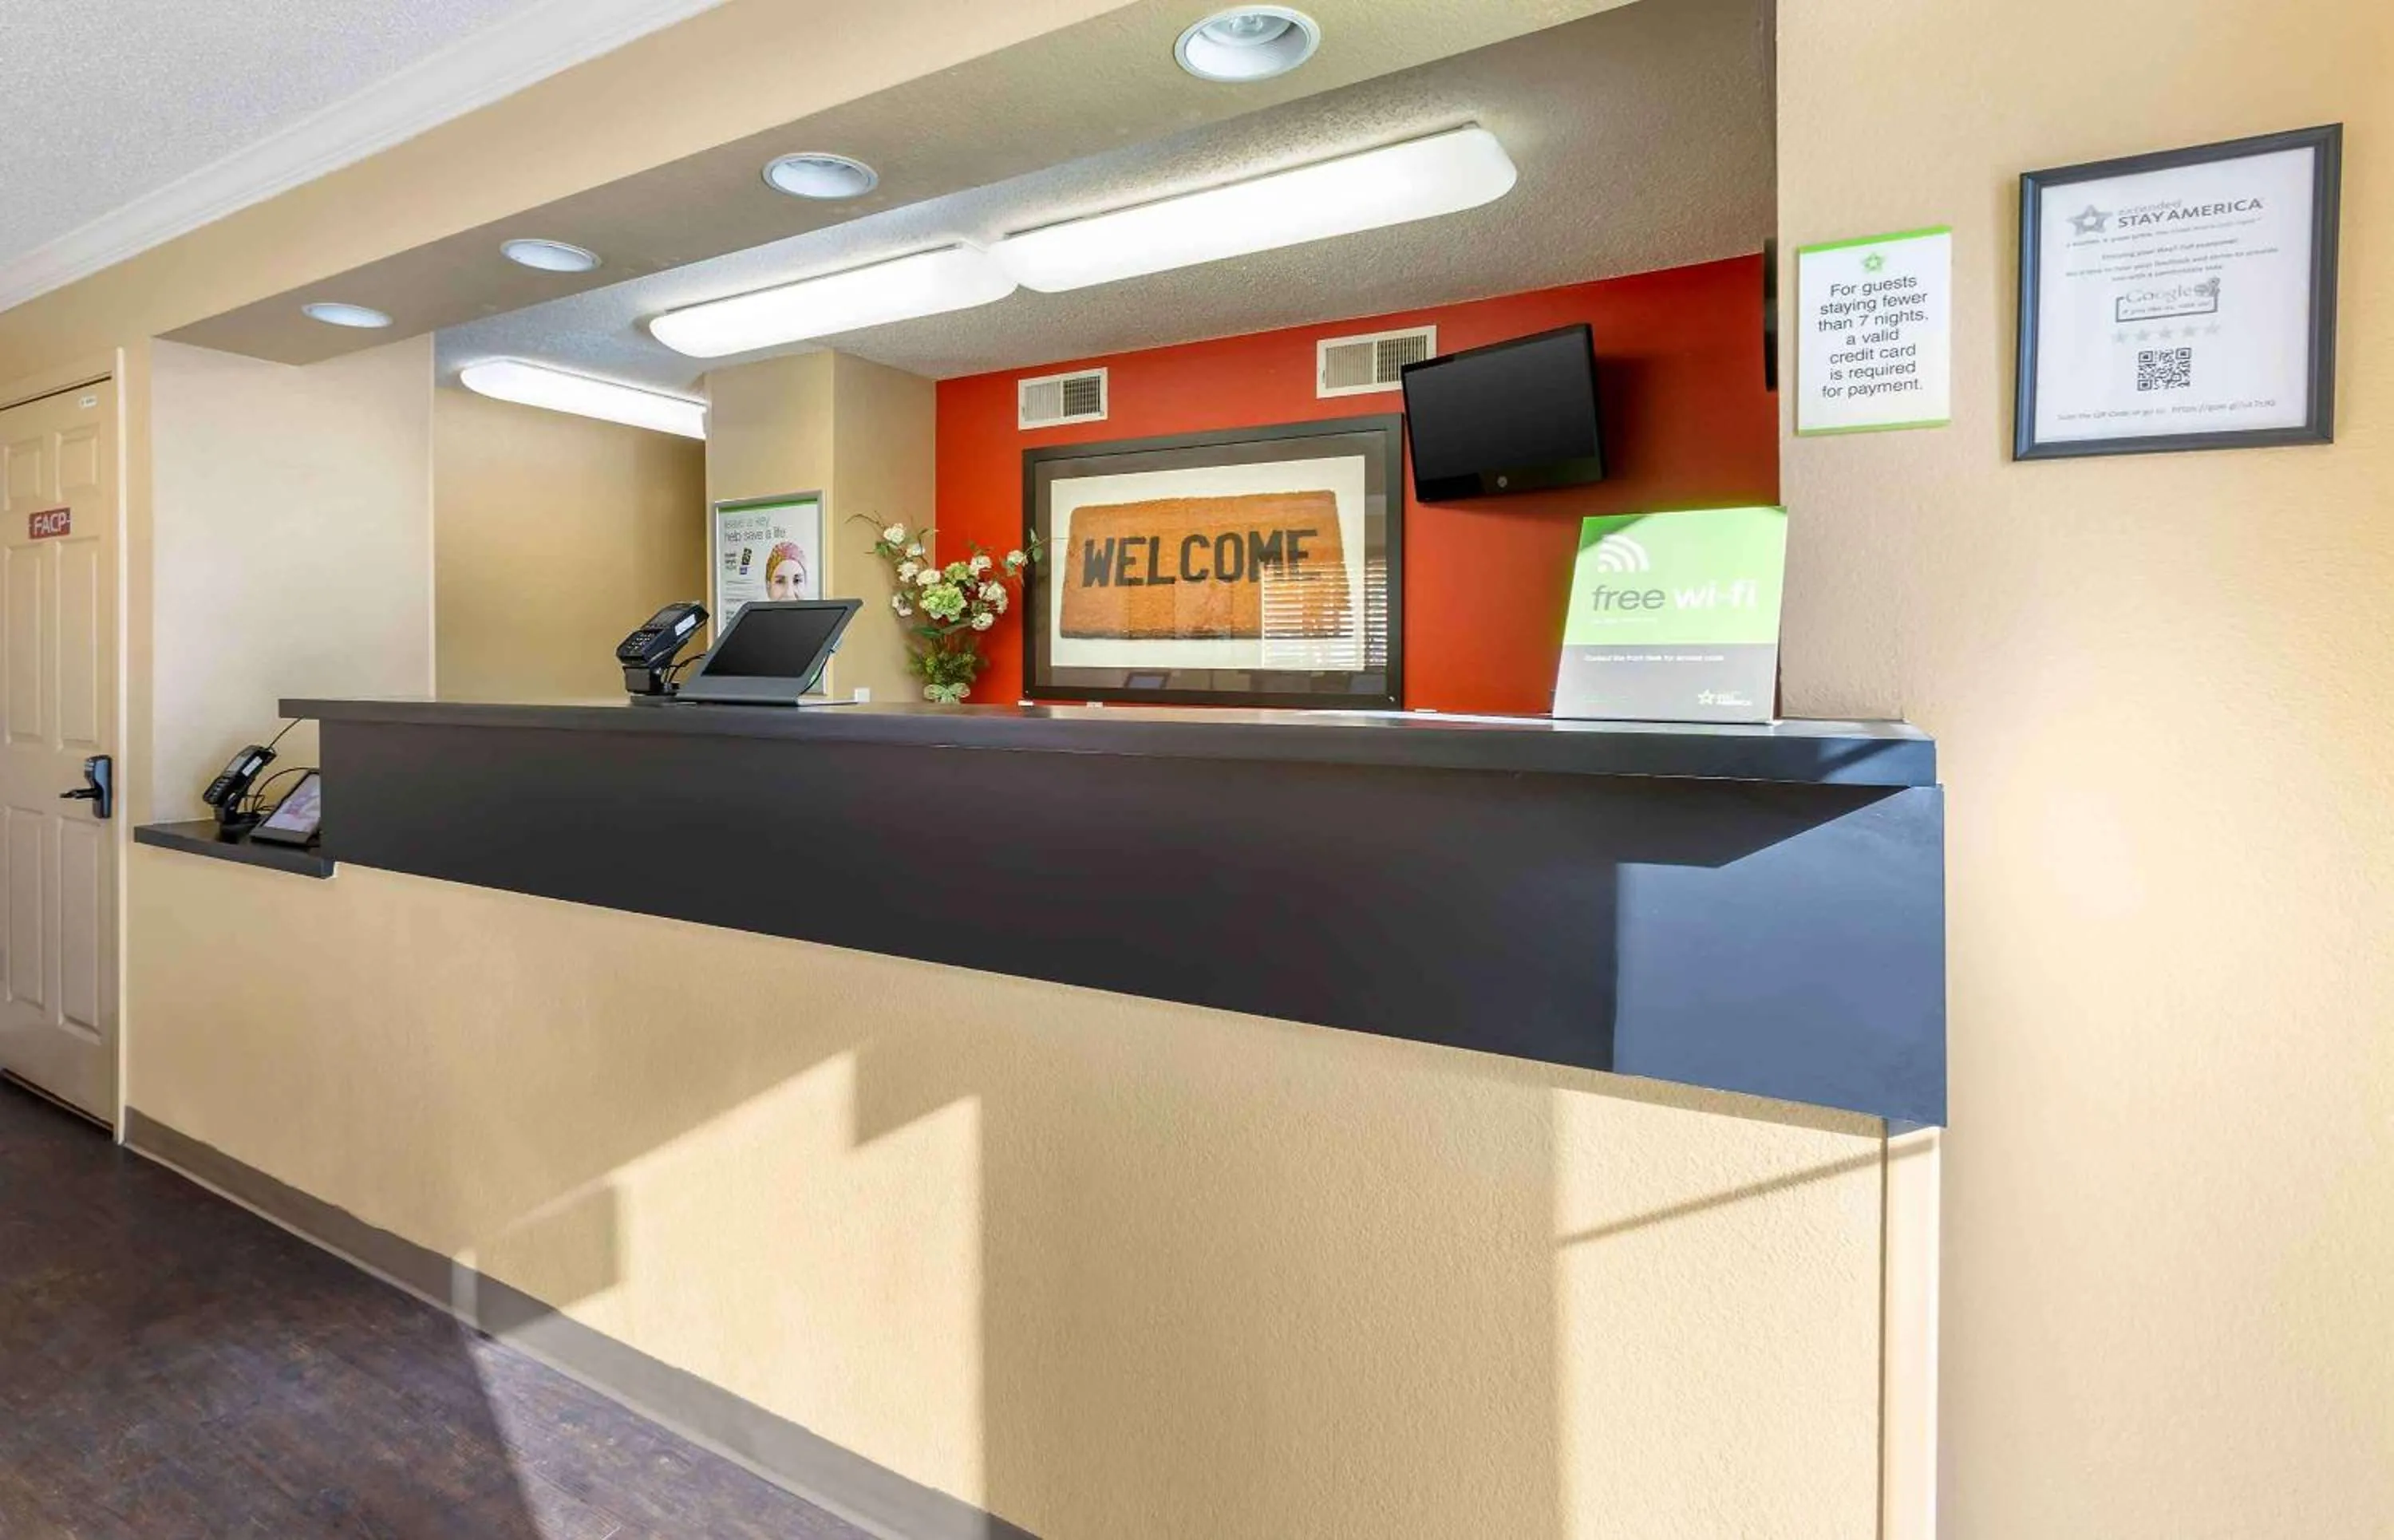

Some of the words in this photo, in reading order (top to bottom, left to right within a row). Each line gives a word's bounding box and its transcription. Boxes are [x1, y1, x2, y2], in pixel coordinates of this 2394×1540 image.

[2118, 211, 2165, 228] STAY
[2167, 198, 2264, 221] AMERICA
[1830, 283, 1856, 298] For
[1862, 275, 1918, 296] guests
[2126, 284, 2192, 303] Google
[1820, 298, 1876, 315] staying
[1882, 292, 1928, 308] fewer
[1819, 318, 1852, 332] than
[1859, 314, 1869, 326] 7
[1846, 334, 1856, 346] a
[1862, 328, 1899, 344] valid
[1830, 348, 1874, 365] credit
[1879, 344, 1916, 359] card
[1830, 368, 1843, 381] is
[1849, 361, 1916, 380] required
[1822, 385, 1843, 398] for
[1847, 378, 1923, 399] payment.
[1082, 529, 1321, 587] WELCOME
[1591, 585, 1666, 611] free
[1675, 580, 1757, 609] wi-fi
